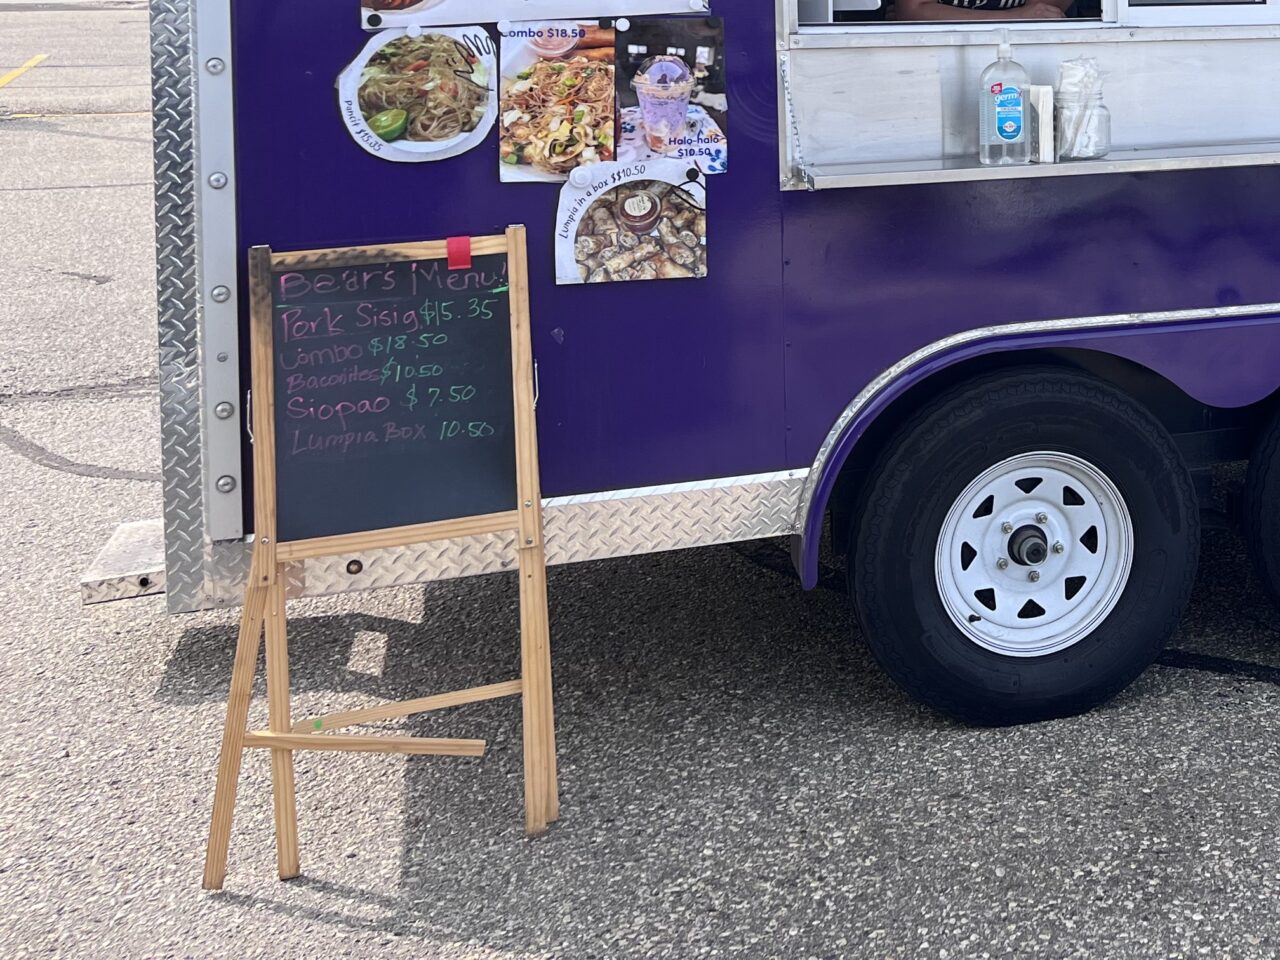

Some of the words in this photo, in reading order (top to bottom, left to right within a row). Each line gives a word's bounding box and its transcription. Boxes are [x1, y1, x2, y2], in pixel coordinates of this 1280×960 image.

[547, 28, 586, 38] $18.50
[668, 135, 720, 146] Halo-halo
[677, 147, 711, 158] $10.50
[560, 207, 578, 239] Lumpia
[577, 196, 586, 208] in
[592, 180, 609, 192] box
[281, 307, 344, 342] Pork
[420, 298, 498, 326] $15.35
[368, 333, 448, 356] $18.50
[380, 356, 443, 386] $10.50
[286, 396, 390, 431] Siopao
[291, 429, 379, 455] Lumpia
[440, 420, 495, 440] 10.50
